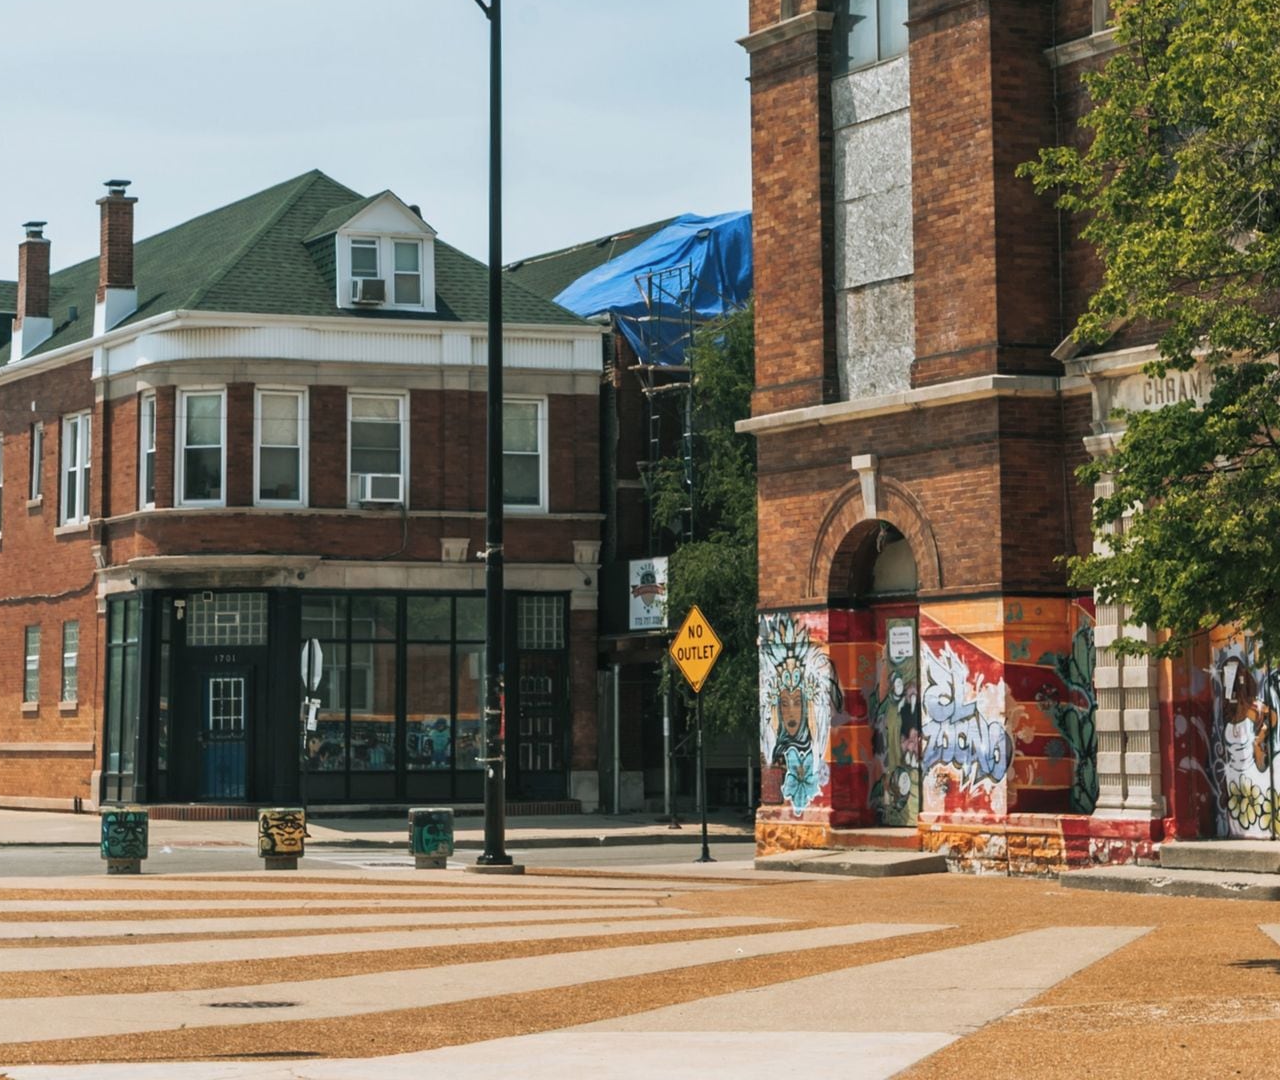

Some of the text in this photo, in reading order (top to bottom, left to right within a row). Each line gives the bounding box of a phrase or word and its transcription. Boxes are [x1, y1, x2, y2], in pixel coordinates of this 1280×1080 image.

[688, 624, 703, 639] NO
[215, 654, 236, 662] 1701
[677, 644, 715, 661] OUTLET
